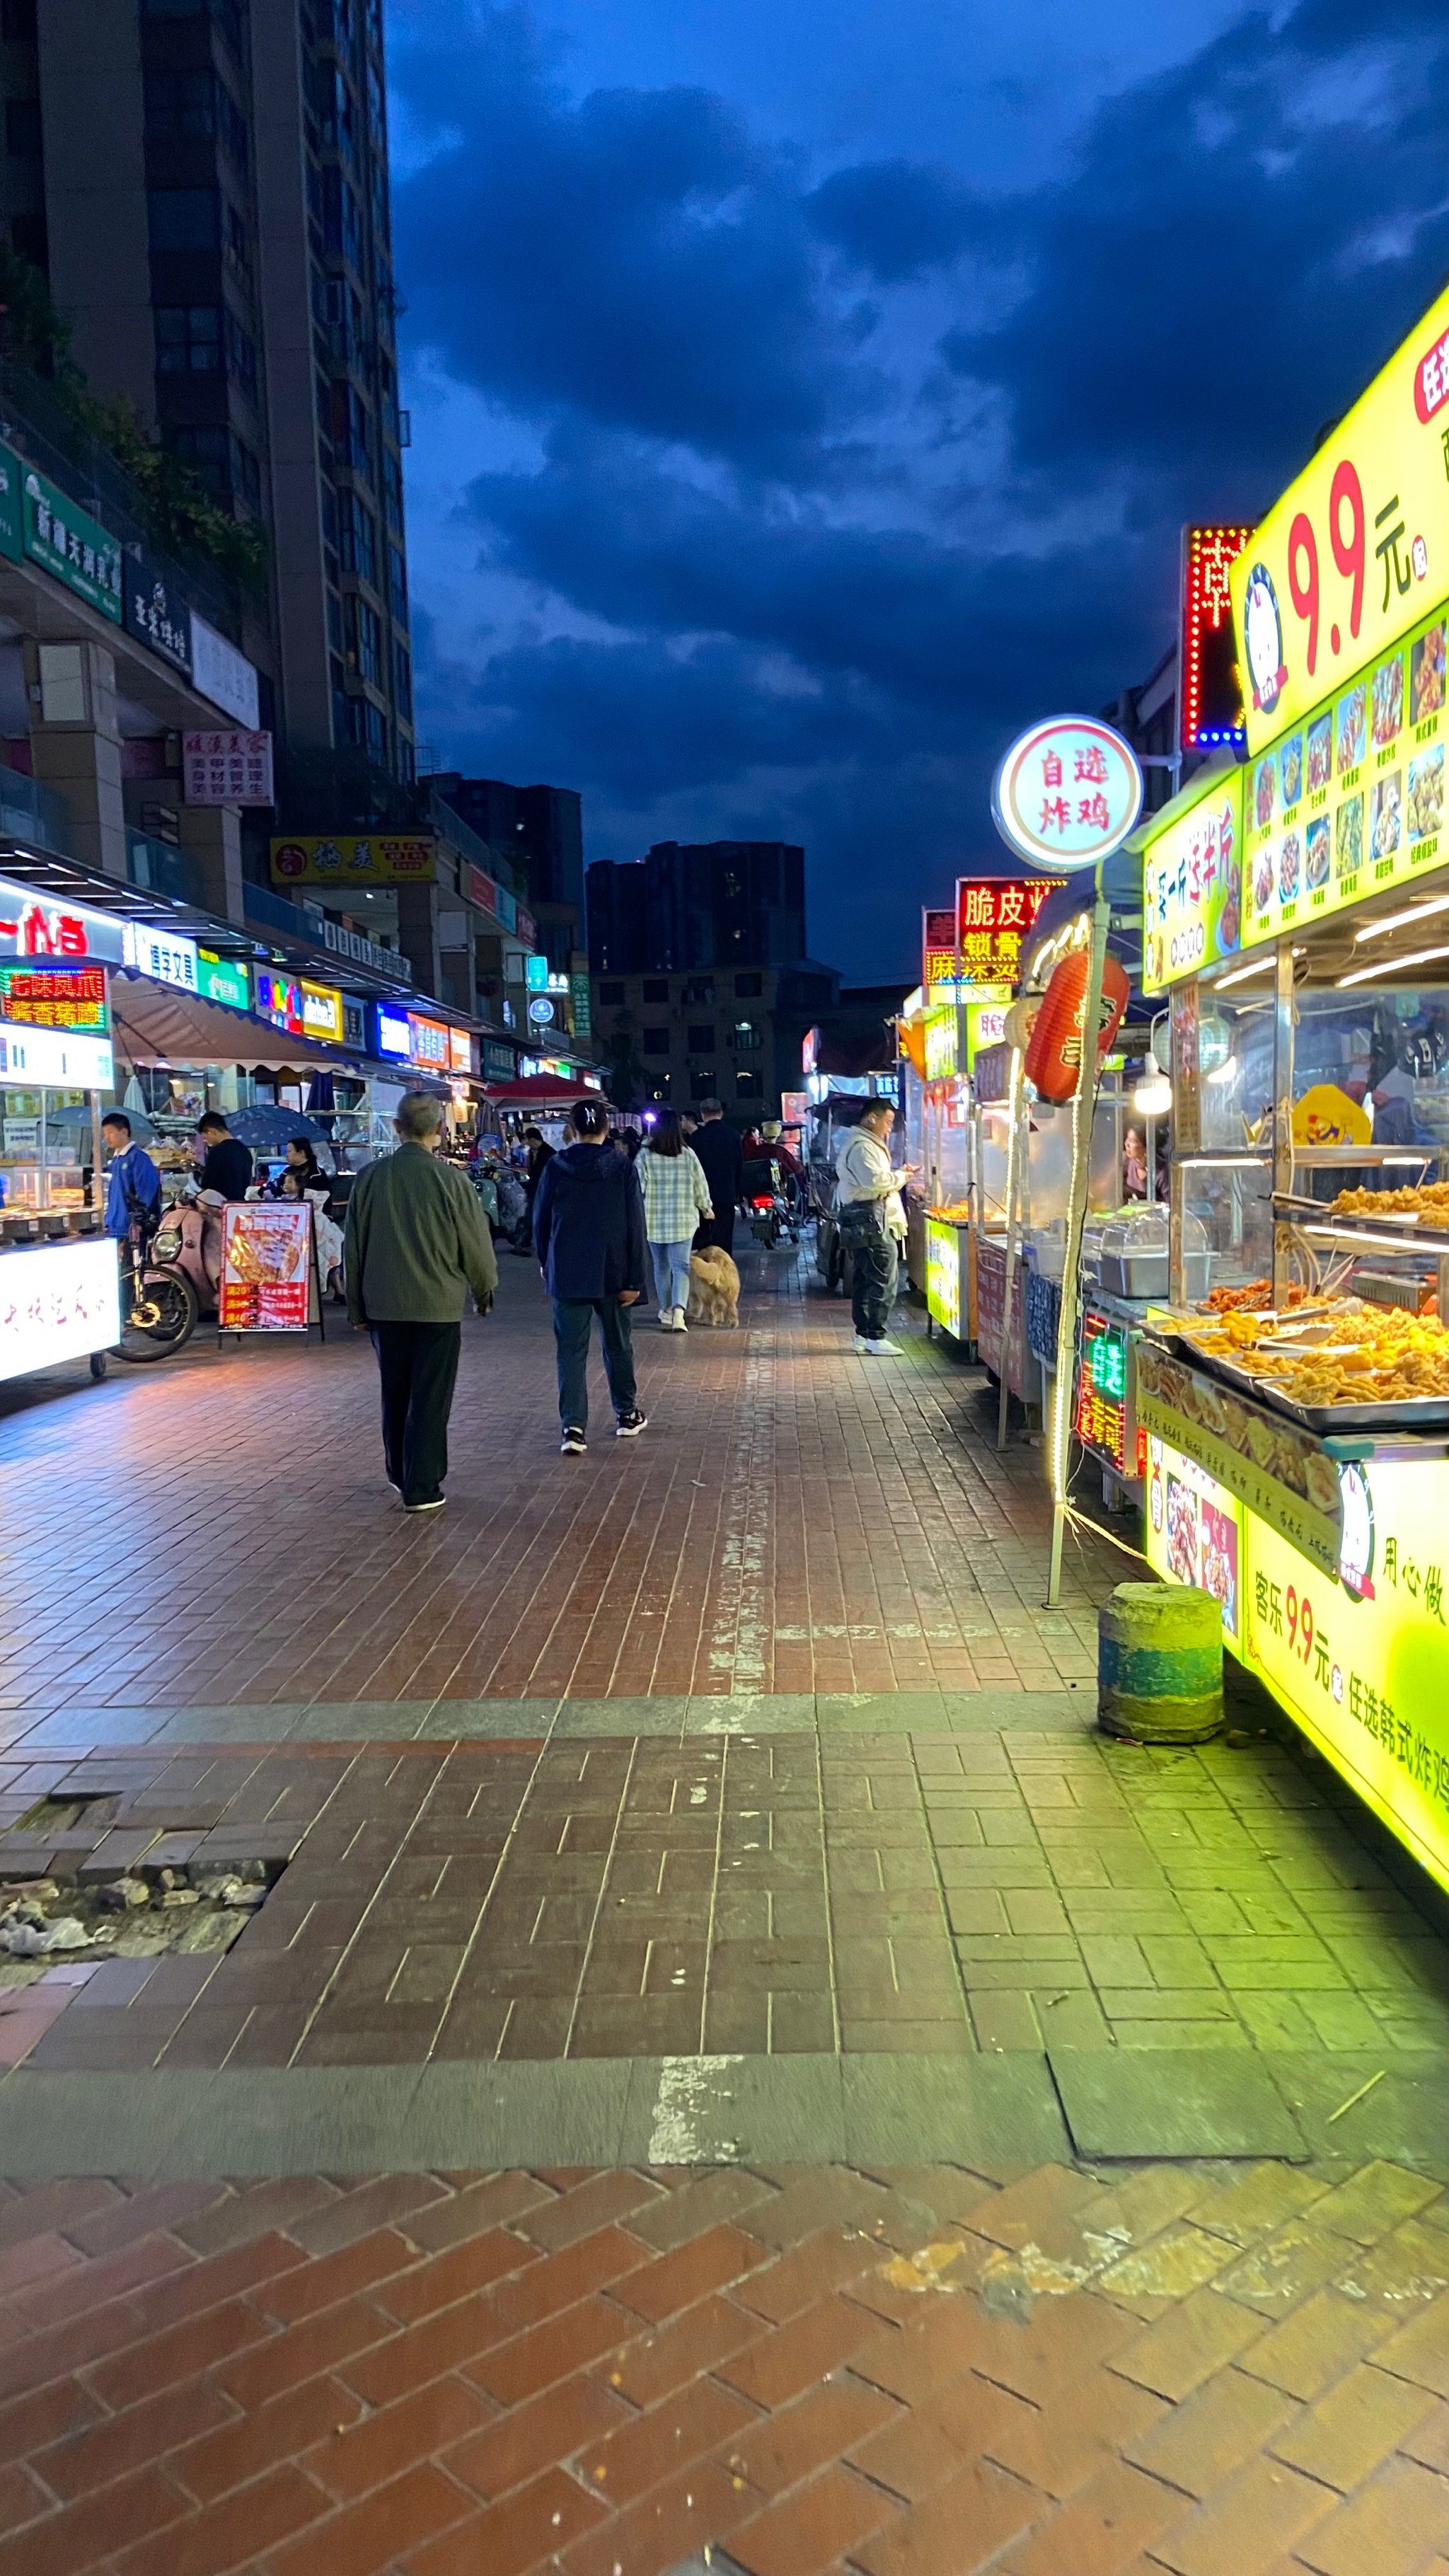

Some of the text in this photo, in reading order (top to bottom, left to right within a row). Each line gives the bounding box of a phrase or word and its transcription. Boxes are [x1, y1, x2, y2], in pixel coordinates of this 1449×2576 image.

[1041, 745, 1108, 788] 自选
[1039, 791, 1110, 834] 炸鸡
[964, 931, 1022, 958] 锁骨
[1383, 1536, 1446, 1626] 用心做
